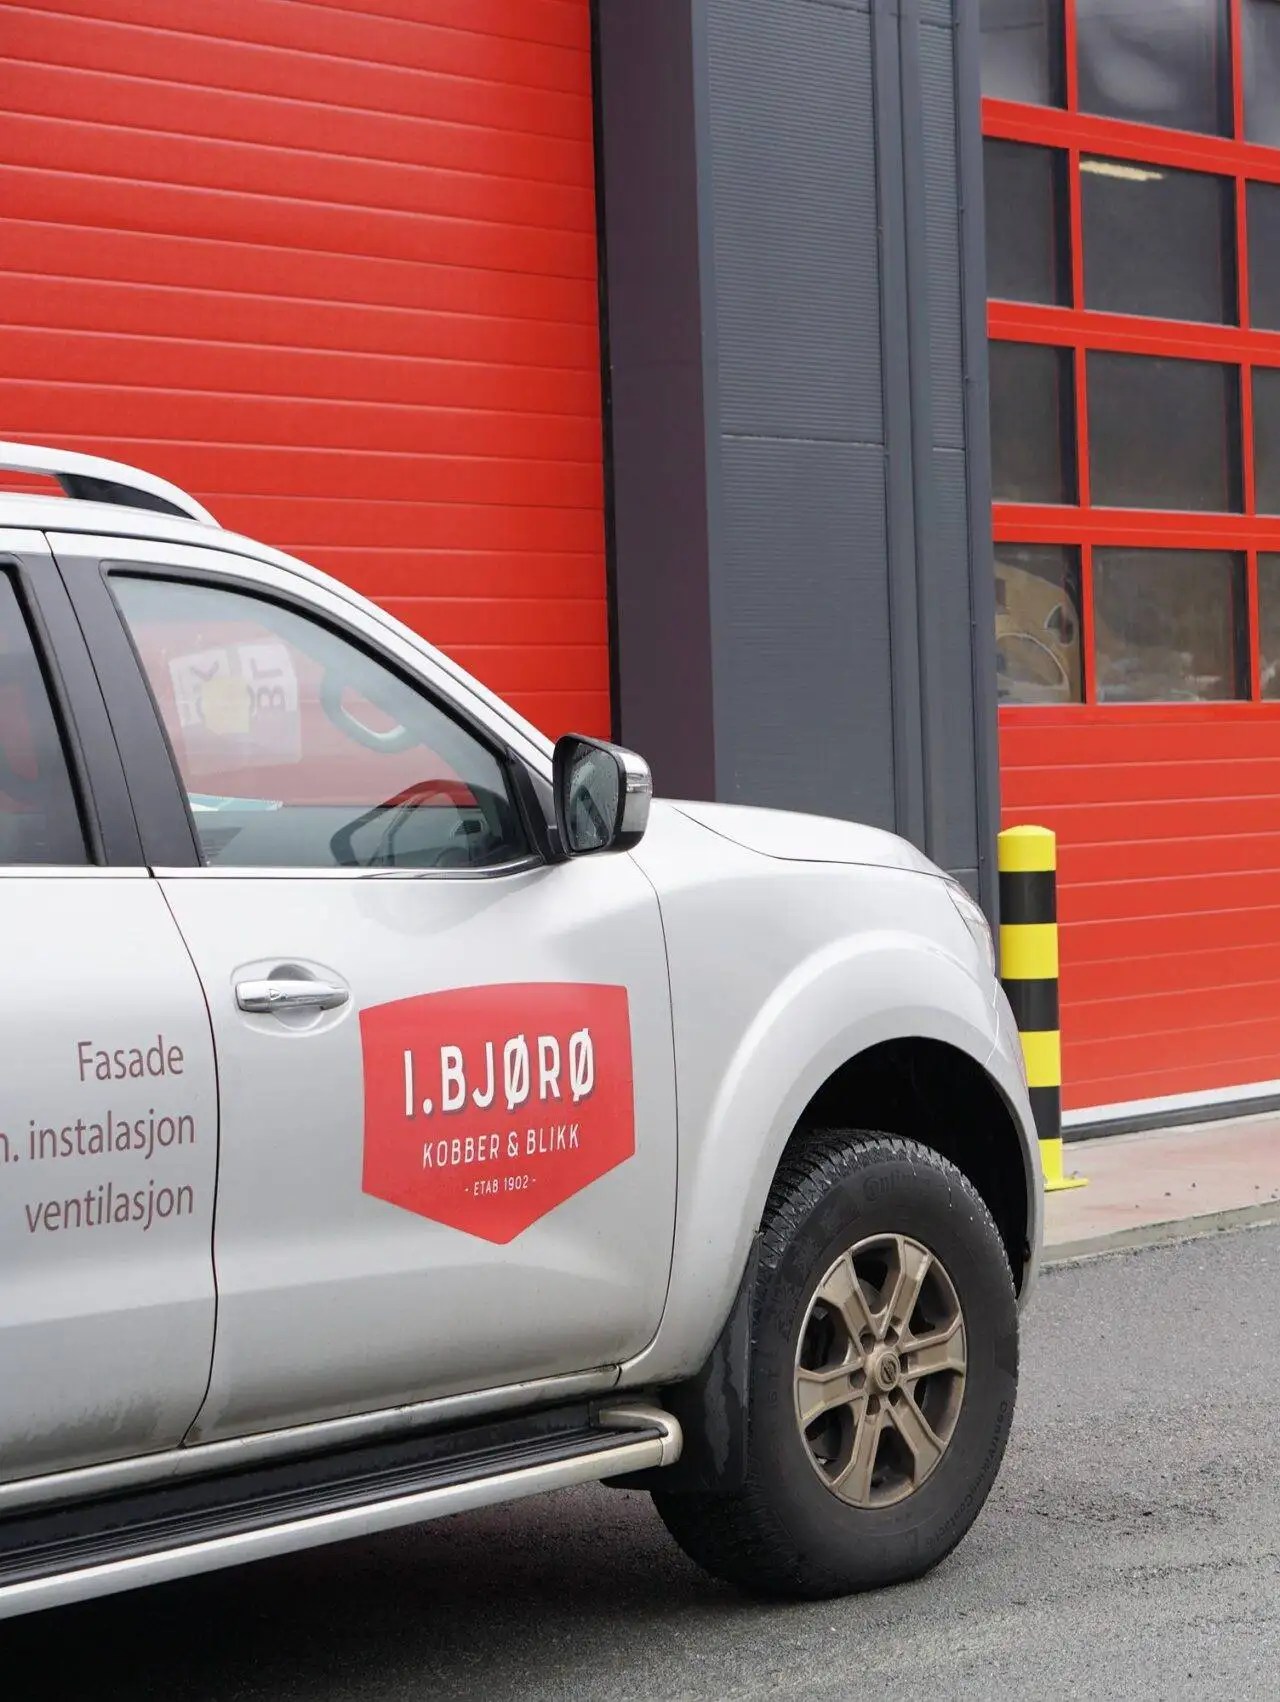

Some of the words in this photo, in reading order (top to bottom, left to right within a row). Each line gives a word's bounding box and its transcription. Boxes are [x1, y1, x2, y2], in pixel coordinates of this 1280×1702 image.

[77, 1034, 184, 1082] Fasade
[404, 1027, 595, 1117] I.BJØRØ
[28, 1108, 196, 1161] instalasjon
[422, 1133, 501, 1169] KOBBER
[507, 1131, 519, 1158] &
[526, 1123, 580, 1155] BLIKK
[25, 1179, 195, 1233] ventilasjon
[503, 1174, 530, 1192] 1902
